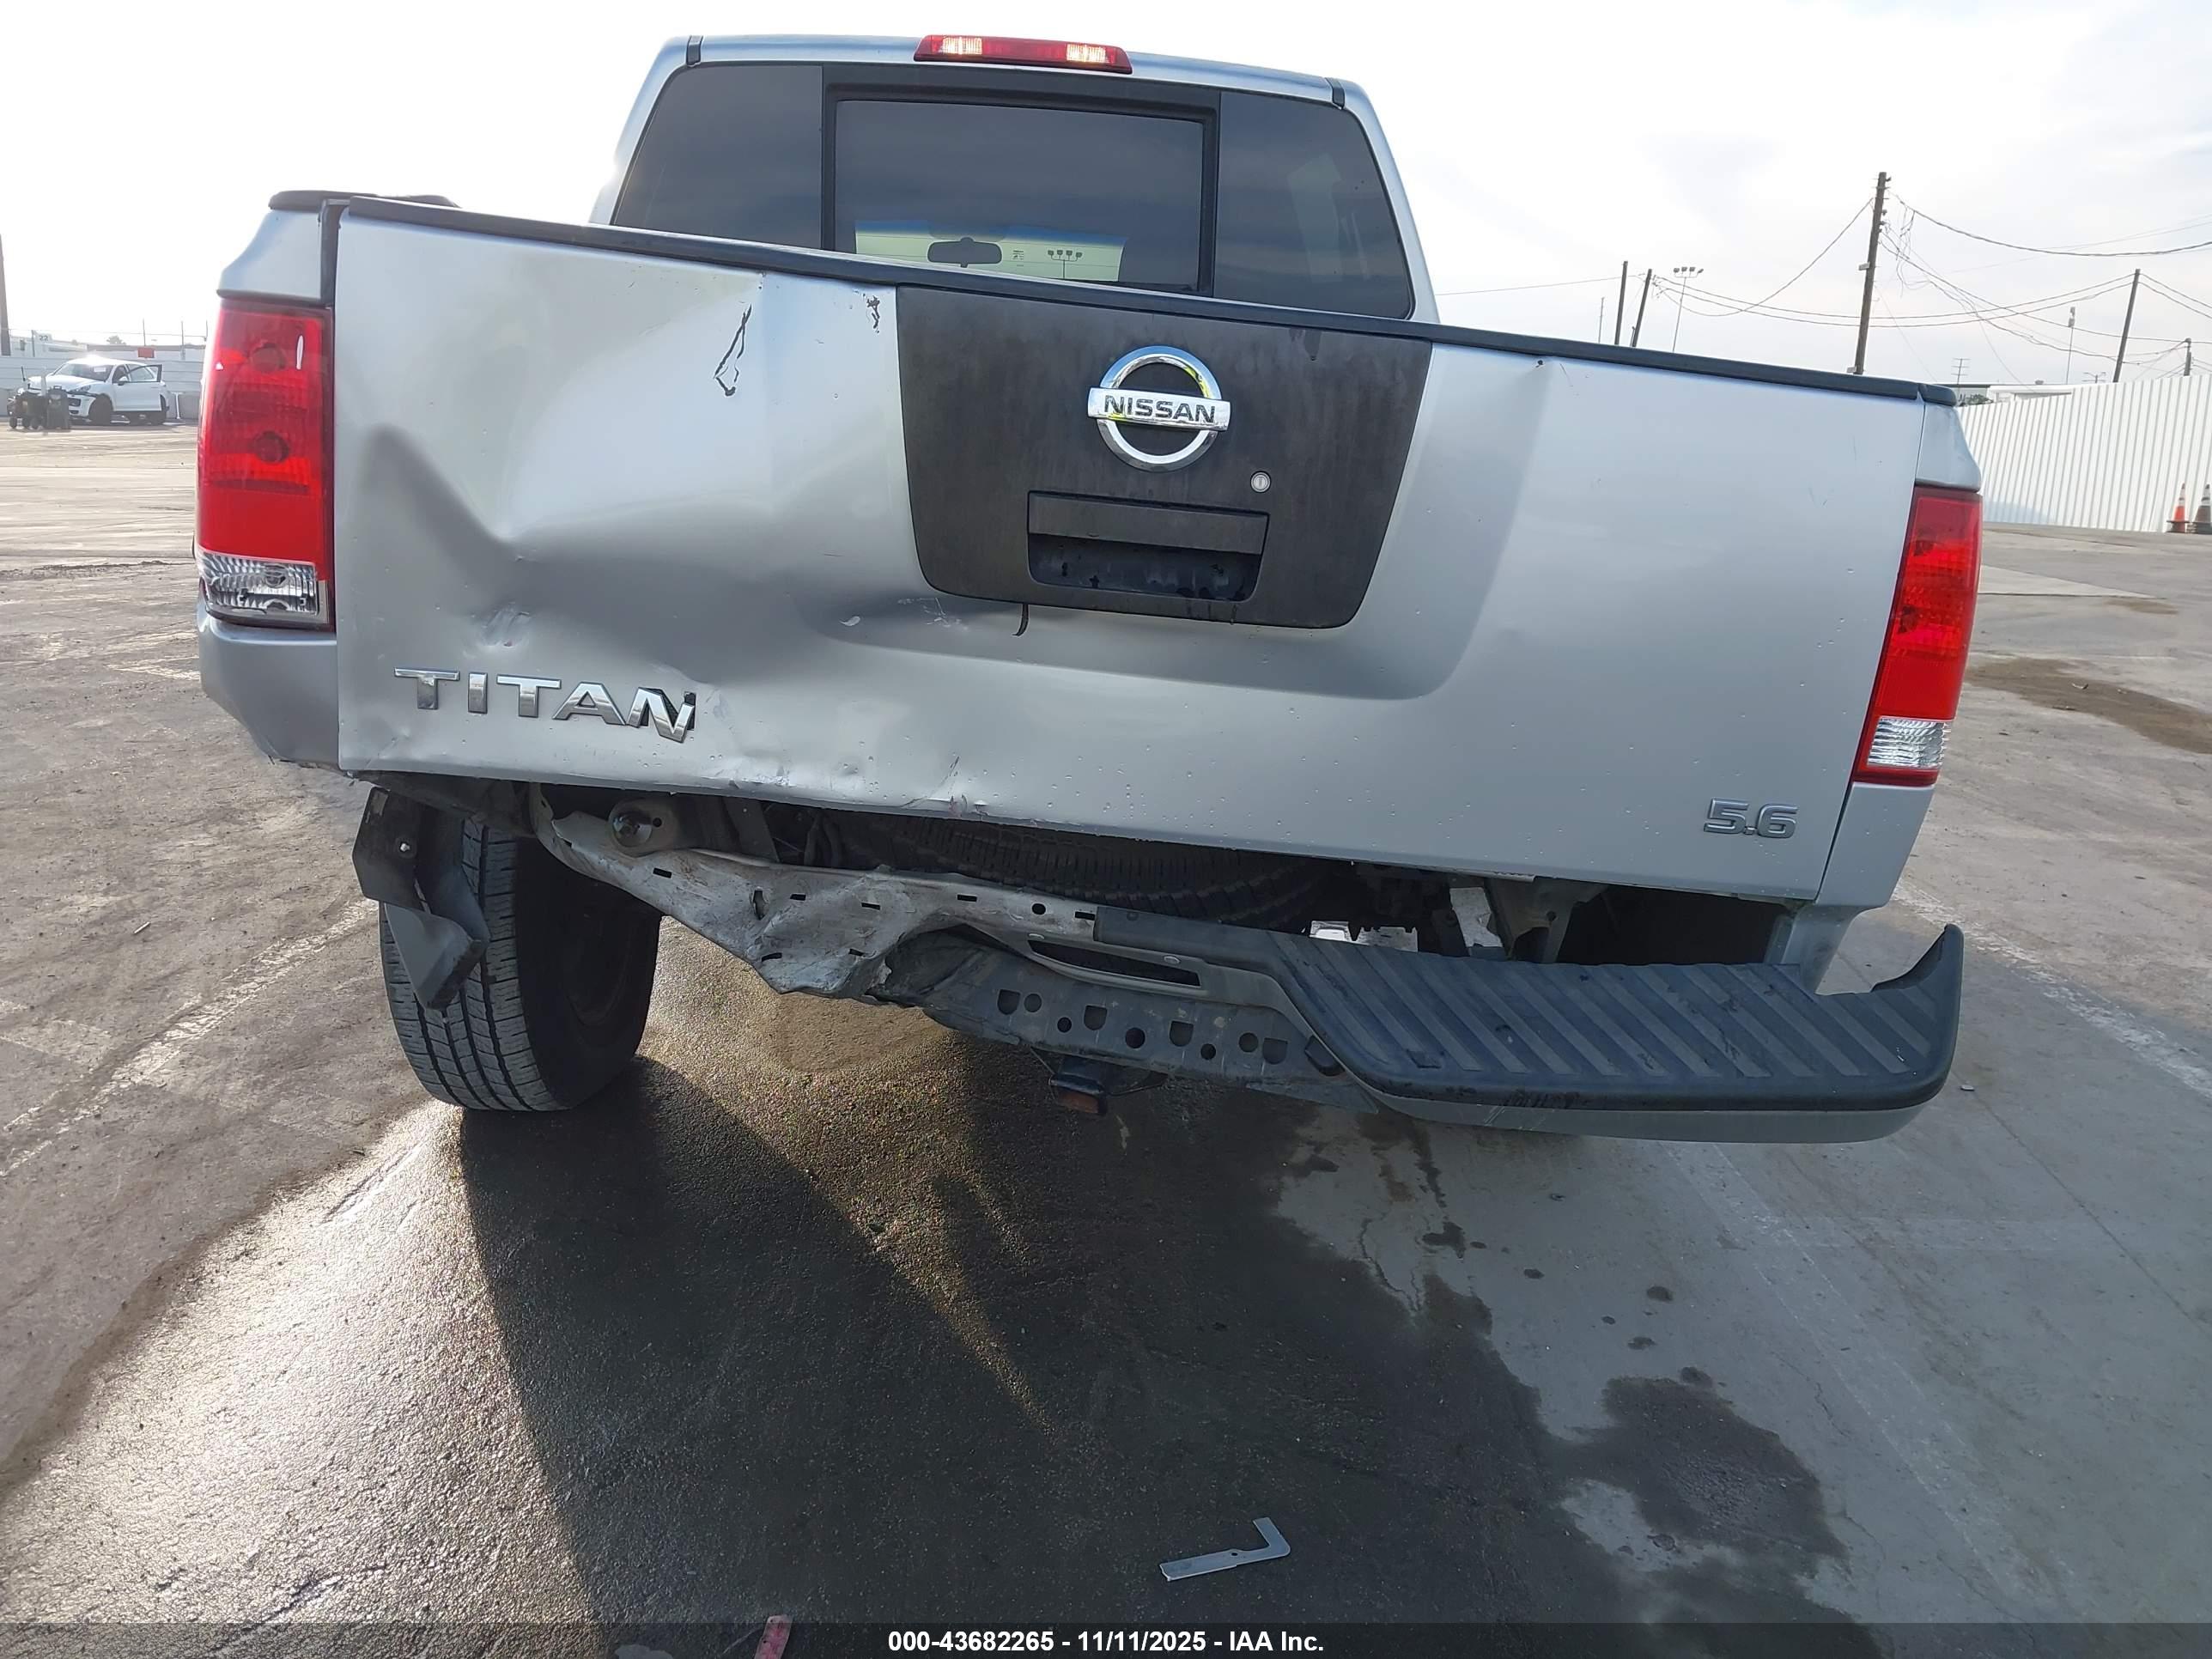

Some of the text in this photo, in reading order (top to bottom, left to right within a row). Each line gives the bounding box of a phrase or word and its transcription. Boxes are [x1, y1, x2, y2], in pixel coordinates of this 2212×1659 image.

[1104, 395, 1216, 423] NISSAN
[394, 667, 696, 743] TITAN
[1704, 798, 1799, 839] 5.6
